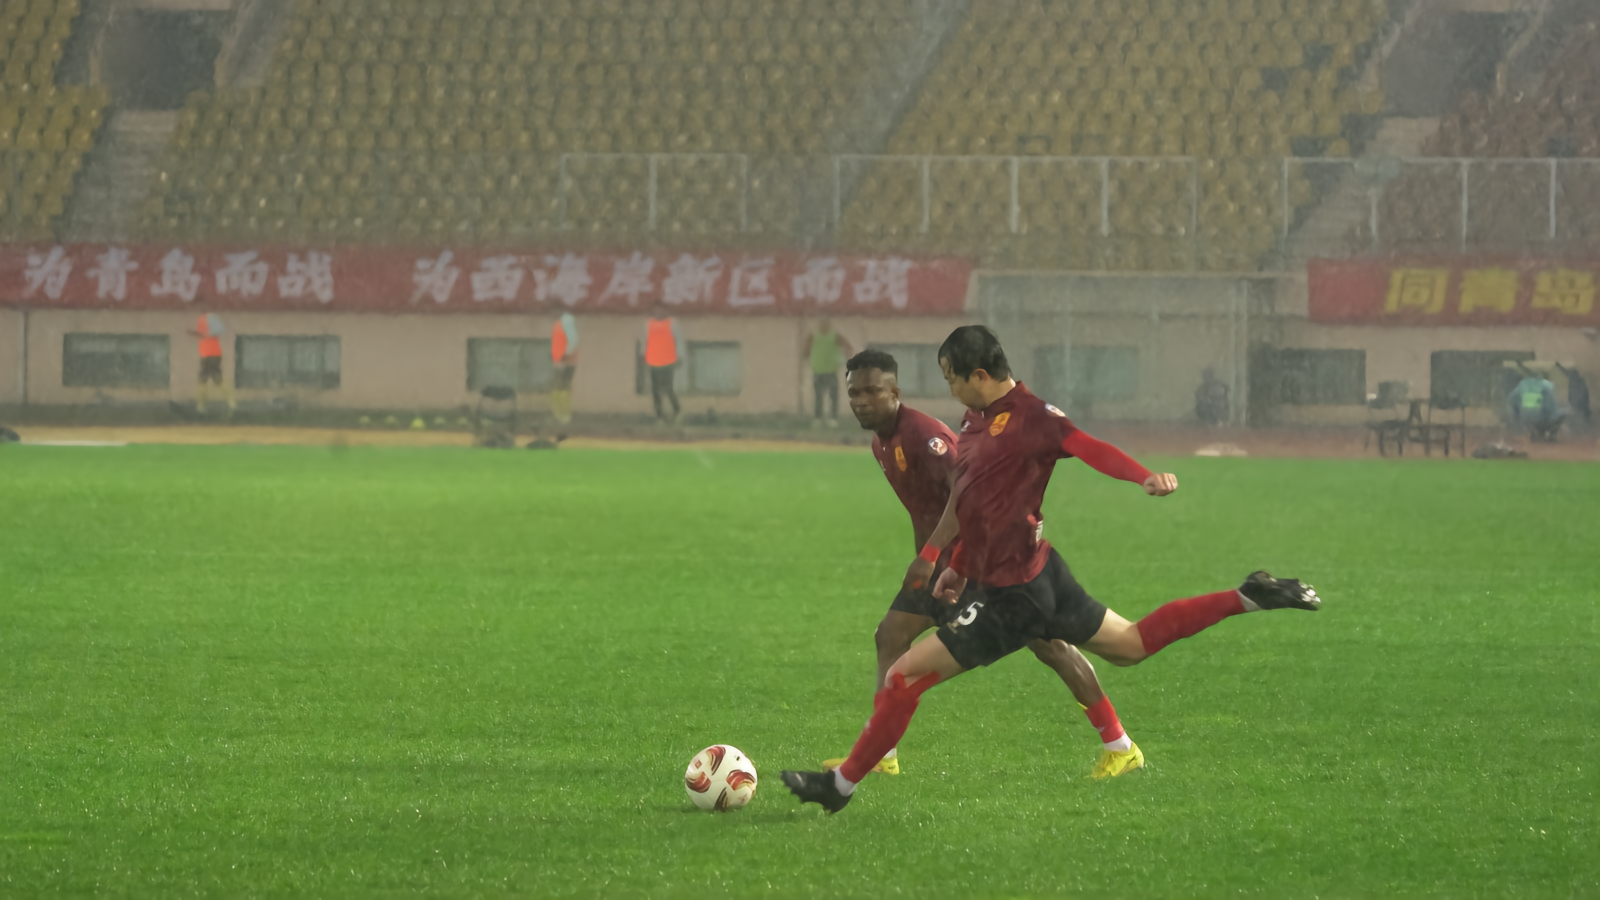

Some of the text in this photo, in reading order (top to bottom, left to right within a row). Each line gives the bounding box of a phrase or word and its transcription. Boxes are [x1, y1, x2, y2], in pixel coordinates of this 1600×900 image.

[25, 246, 335, 303] 为青岛而战
[411, 250, 913, 308] 为西海岸新区而战
